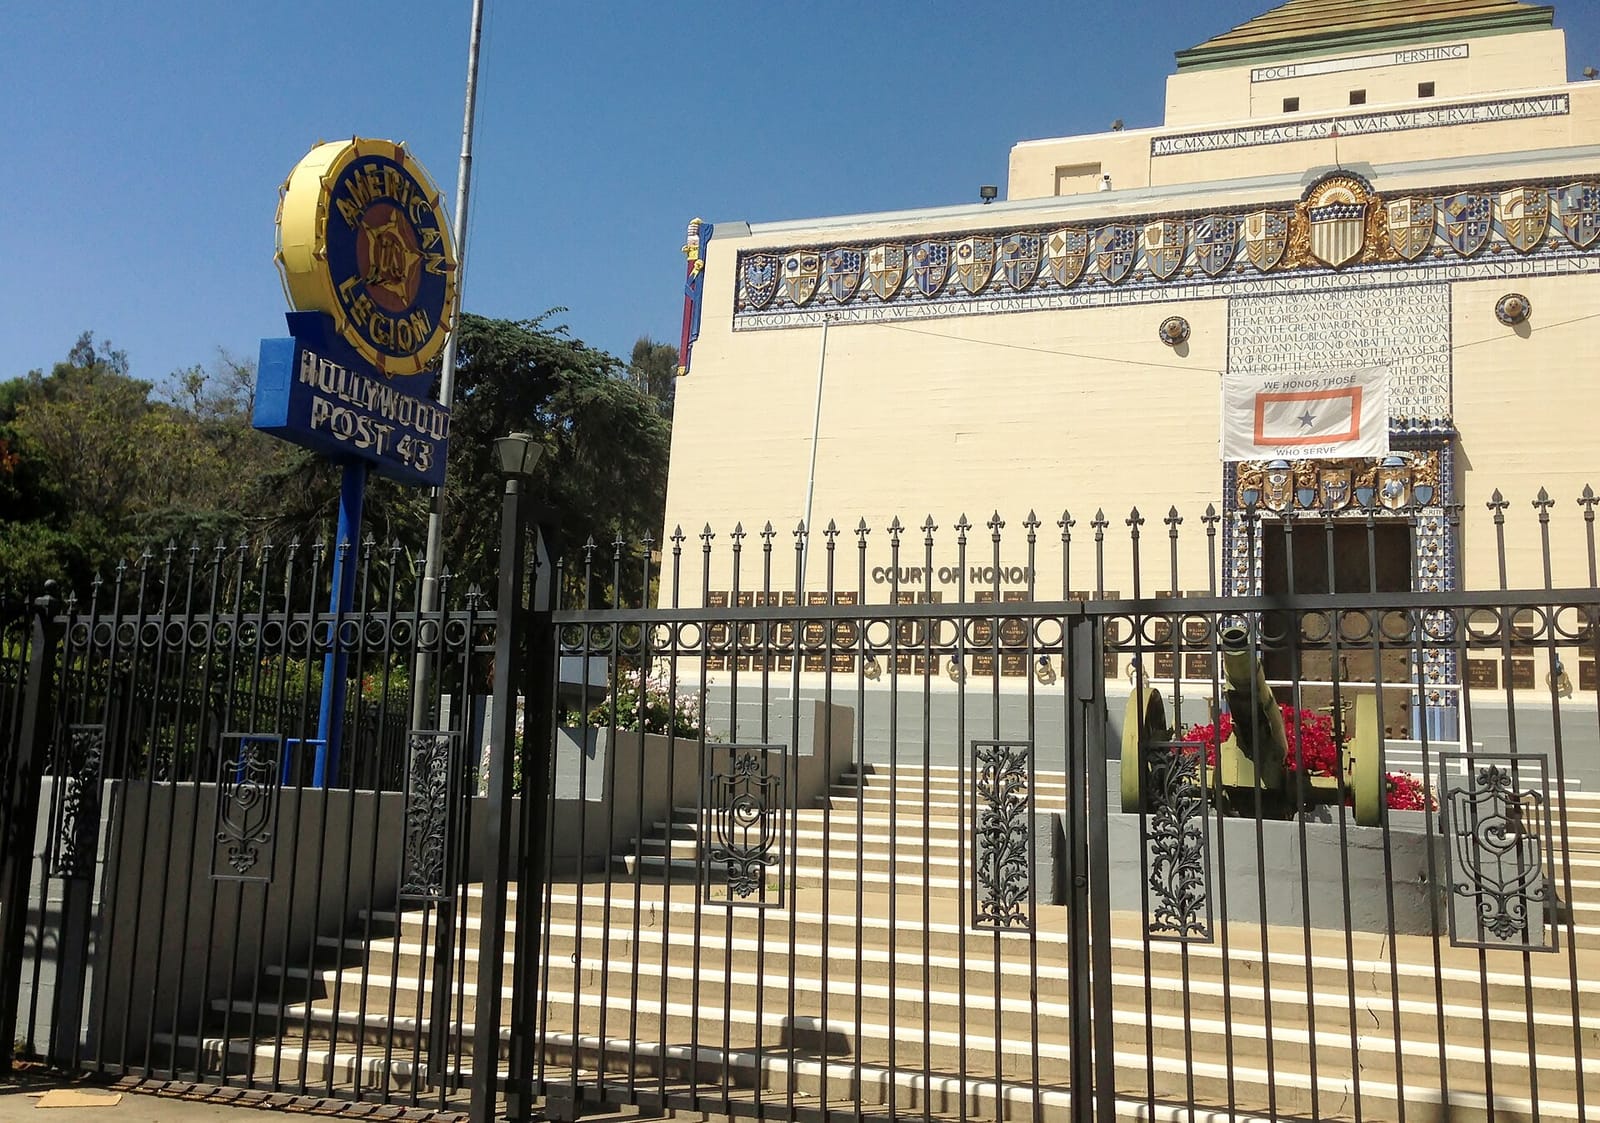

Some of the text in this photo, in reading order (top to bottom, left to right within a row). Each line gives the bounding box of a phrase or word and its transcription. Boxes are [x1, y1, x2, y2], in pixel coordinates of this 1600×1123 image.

[1256, 66, 1297, 81] FOCH
[1394, 46, 1462, 64] PERSHING
[1159, 135, 1229, 152] MCMXXIX
[1232, 132, 1248, 146] IN
[1253, 127, 1304, 143] PEACE
[1308, 123, 1327, 138] AS
[1352, 116, 1389, 132] WAR
[1393, 112, 1422, 127] WE
[1427, 106, 1480, 122] SERVE
[1486, 98, 1560, 118] MCMXVII
[336, 163, 447, 277] AMERICAN
[339, 275, 431, 354] LEGION
[740, 316, 763, 326] FOR
[765, 314, 791, 325] GOD
[796, 312, 821, 323] AND
[824, 309, 885, 321] OUNTRY
[892, 307, 913, 317] WE
[991, 296, 1063, 310] OURSELVES
[1141, 289, 1169, 301] FOR
[1175, 286, 1204, 298] THE
[1303, 272, 1376, 288] PURPOSES
[1386, 269, 1409, 282] TO
[1480, 263, 1513, 276] AND
[1521, 258, 1589, 273] DEFEND
[299, 348, 451, 441] HOLLYWOOD
[1263, 375, 1357, 390] WE HONOR THOSE
[310, 395, 435, 473] POST 43
[1276, 446, 1337, 456] WHO SERVE
[871, 566, 1036, 584] COURT OF HONOR
